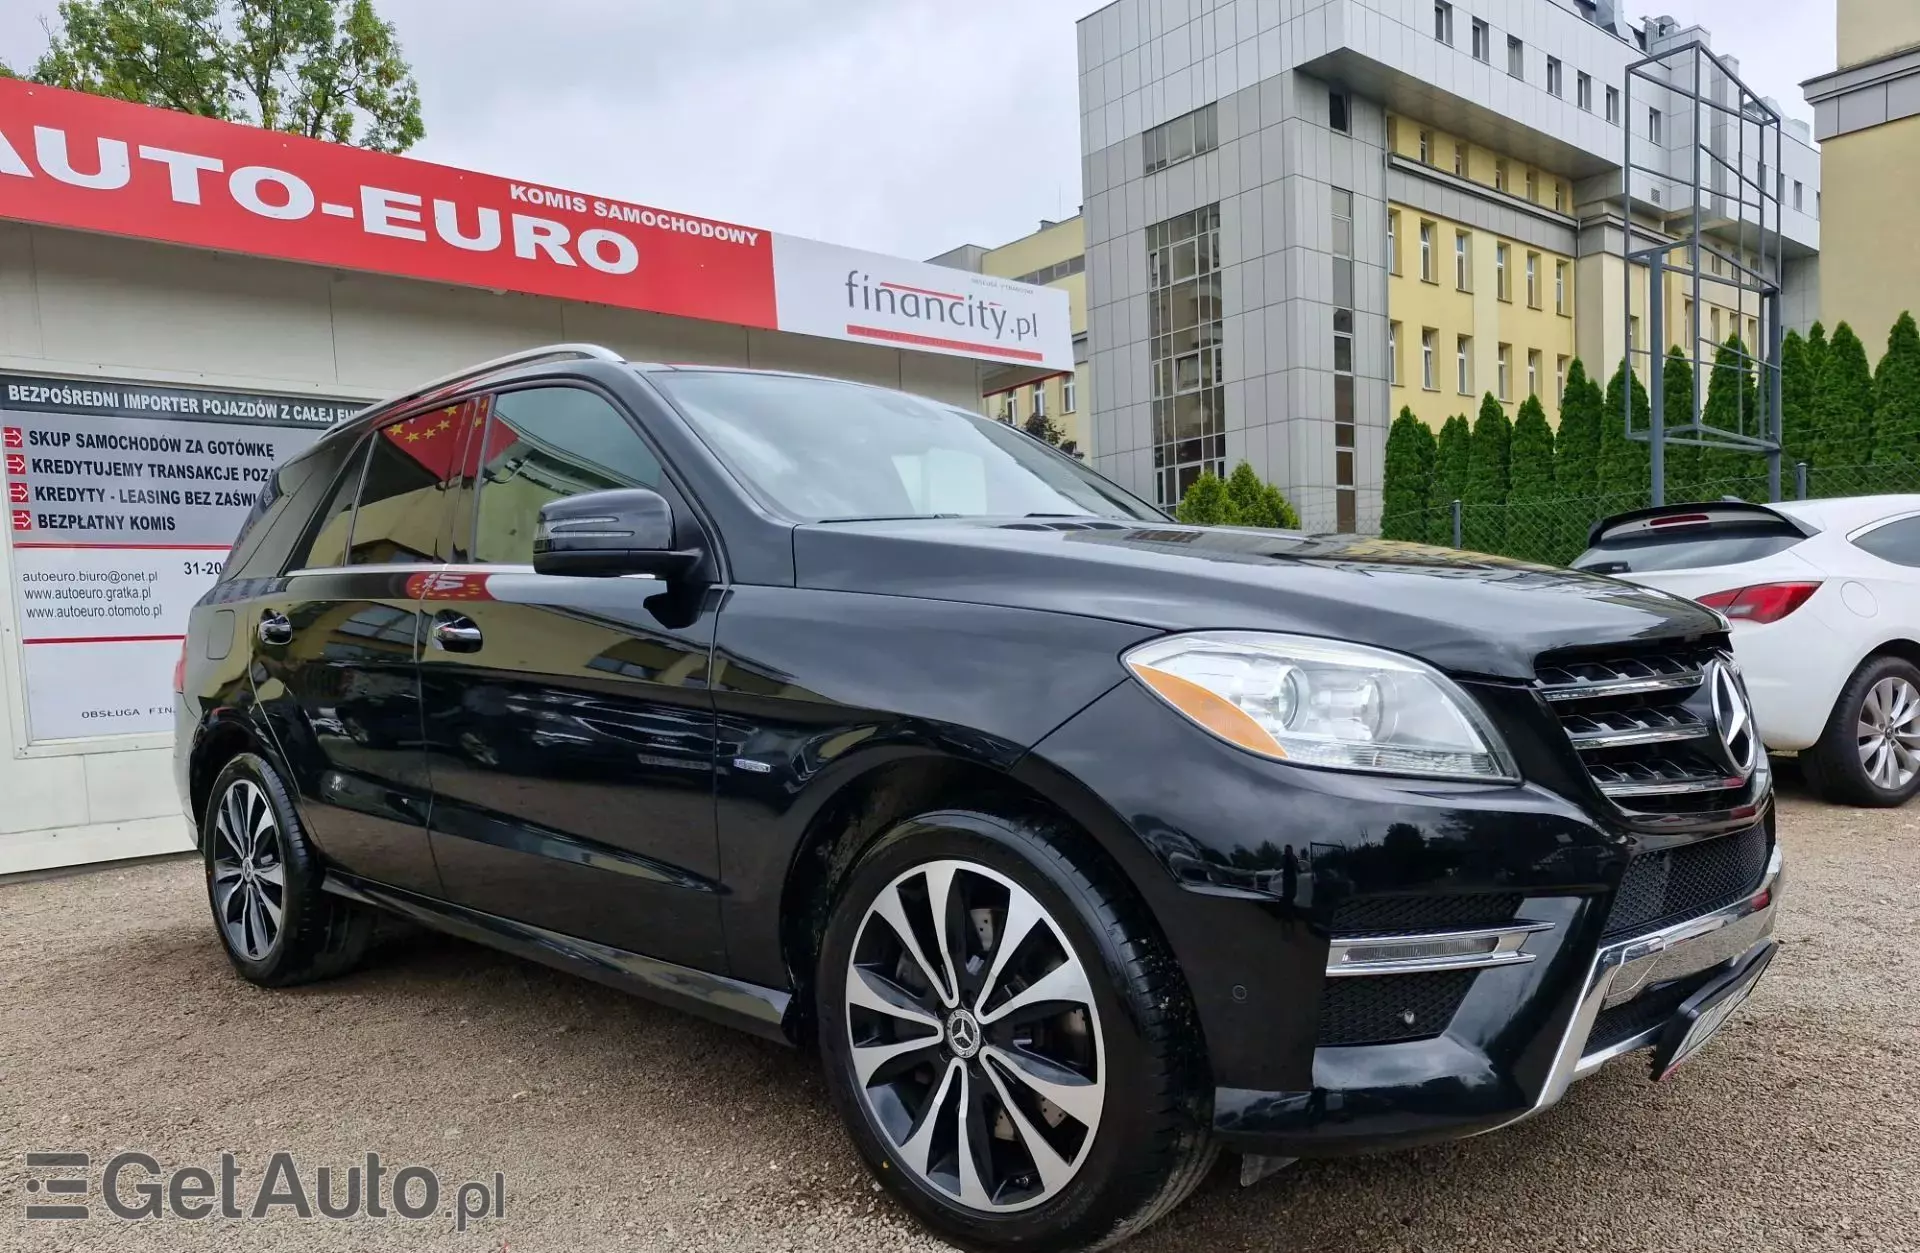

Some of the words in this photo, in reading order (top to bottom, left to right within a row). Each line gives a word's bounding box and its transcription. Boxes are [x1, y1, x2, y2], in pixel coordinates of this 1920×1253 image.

[510, 184, 587, 213] KOMIS
[594, 199, 759, 247] SAMOCHODOWY
[845, 270, 1038, 341] financity.pl
[8, 384, 119, 408] BEZPOŚREDNI
[123, 393, 200, 413] IMPORTER
[203, 399, 277, 419] POJAZDÓW
[280, 405, 291, 420] Z
[293, 406, 334, 422] CAŁEJ
[29, 430, 71, 448] SKUP
[76, 433, 181, 453] SAMOCHODÓW
[185, 439, 204, 454] ZA
[207, 439, 274, 461] GOTÓWKĘ
[31, 458, 143, 477] KREDYTUJEMY
[148, 463, 240, 481] TRANSAKCJE
[243, 467, 275, 482] POZ
[35, 486, 105, 503] KREDYTY
[119, 489, 181, 505] LEASING
[184, 491, 212, 506] BEZ
[37, 514, 125, 530] BEZPŁATNY
[130, 516, 176, 531] KOMIS
[22, 570, 158, 584] autoeuro.biuro@onet.pl
[24, 586, 152, 602] www.autoeuro.gratka.pl
[26, 603, 162, 619] www.autoeuro.otomoto.pl
[81, 708, 141, 719] OBSŁUGA
